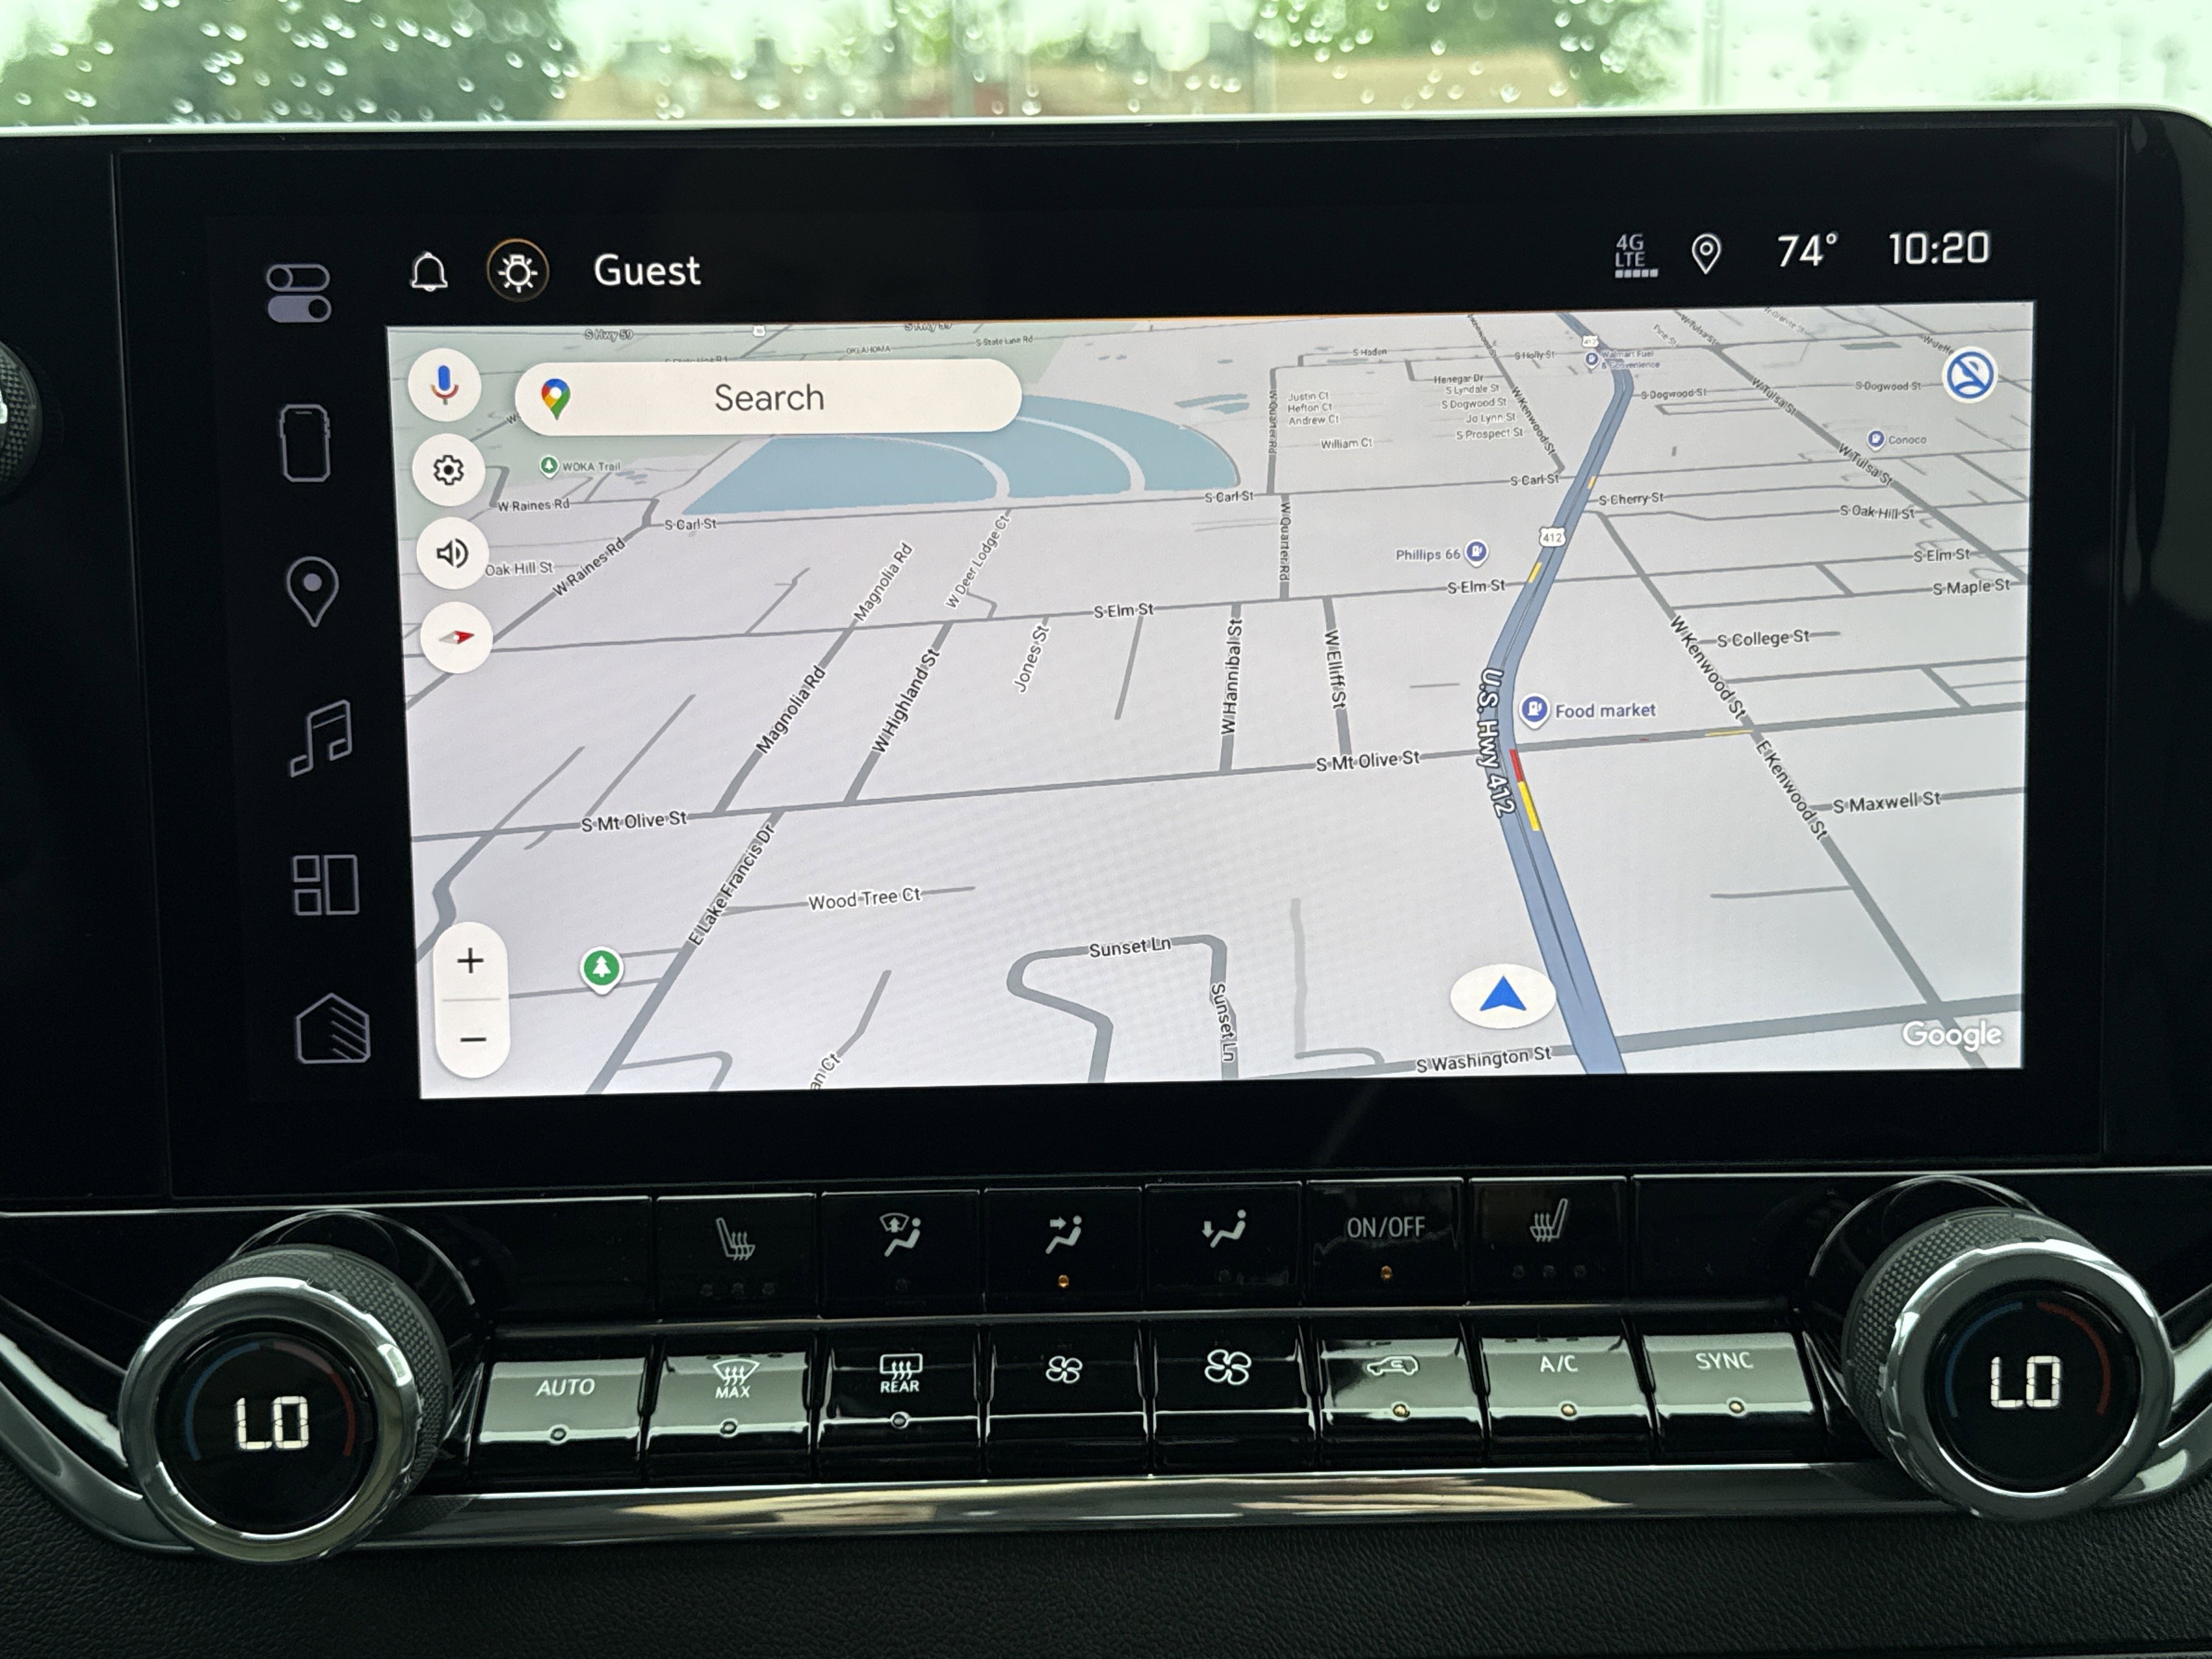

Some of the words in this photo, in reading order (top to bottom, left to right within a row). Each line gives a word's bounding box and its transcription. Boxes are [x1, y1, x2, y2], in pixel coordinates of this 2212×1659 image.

[1616, 234, 1644, 250] 4G
[1778, 233, 1837, 266] 74°
[1889, 231, 1991, 264] 10:20
[1616, 252, 1645, 266] LTE
[594, 253, 701, 286] Guest
[1446, 386, 1452, 394] S
[1454, 385, 1488, 396] Lyndale
[1491, 383, 1499, 392] St
[1856, 382, 1861, 390] S
[1865, 381, 1909, 392] Dogwood
[715, 383, 824, 411] Search
[1288, 393, 1316, 402] Justin
[1319, 392, 1329, 400] Ct
[1442, 400, 1448, 409] S
[1451, 398, 1494, 410] Dogwood
[1498, 398, 1506, 406] St
[1752, 377, 1764, 392] W
[1763, 386, 1786, 407] Tulsa
[1784, 400, 1797, 415] St
[1322, 403, 1332, 412] Ct
[1289, 416, 1325, 425] Andrew
[1329, 415, 1339, 424] Ct
[1511, 386, 1521, 398] W
[1517, 398, 1549, 443] Kenwood
[1544, 442, 1556, 455] St
[1457, 431, 1463, 439] S
[1466, 428, 1510, 440] Prospect
[1513, 427, 1523, 437] St
[1889, 436, 1927, 444] Conoco
[1321, 439, 1359, 449] William
[1361, 438, 1373, 448] Ct
[563, 462, 595, 471] WOKA
[599, 461, 620, 471] Trail
[1839, 442, 1854, 457] W
[1851, 451, 1879, 477] Tulsa
[1879, 471, 1892, 487] St
[1510, 476, 1518, 486] S
[1522, 476, 1544, 485] Carl
[1548, 474, 1559, 484] St
[498, 501, 510, 511] W
[512, 500, 550, 511] Raines
[555, 498, 569, 509] Rd
[1205, 493, 1212, 503] S
[1216, 492, 1238, 503] Carl
[1242, 491, 1254, 501] St
[1599, 496, 1606, 505] S
[1611, 494, 1649, 507] Cherry
[1652, 493, 1664, 502] St
[1281, 501, 1291, 514] W
[1840, 506, 1848, 516] S
[1853, 505, 1874, 517] Oak
[1878, 507, 1897, 520] Hill
[1902, 508, 1916, 519] St
[665, 520, 673, 530] S
[676, 519, 701, 530] Carl
[704, 518, 717, 529] St
[1280, 517, 1291, 564] Quarter
[1543, 533, 1562, 543] 412
[945, 595, 960, 610] W
[955, 568, 976, 595] Deer
[972, 530, 1000, 568] Lodge
[995, 514, 1010, 531] Ct
[1396, 549, 1442, 562] Phillips
[1445, 550, 1460, 560] 66
[1914, 550, 1922, 562] S
[1926, 550, 1951, 562] Elm
[1956, 548, 1970, 560] St
[486, 564, 510, 577] Oak
[515, 562, 535, 574] Hill
[539, 562, 553, 574] St
[554, 580, 569, 597] W
[567, 554, 608, 587] Raines
[607, 537, 625, 558] Rd
[1279, 566, 1289, 580] Rd
[854, 563, 900, 622] Magnolia
[894, 543, 912, 565] Rd
[1448, 582, 1457, 595] S
[1462, 581, 1487, 593] Elm
[1491, 580, 1505, 591] St
[1933, 583, 1943, 595] S
[1946, 580, 1990, 596] Maple
[1995, 579, 2010, 591] St
[1094, 607, 1103, 618] S
[1108, 605, 1134, 618] Elm
[1139, 603, 1154, 616] St
[1228, 618, 1243, 636] St
[1325, 629, 1339, 646] W
[1717, 634, 1727, 647] S
[1732, 631, 1789, 650] College
[1794, 629, 1809, 642] St
[1014, 644, 1041, 693] Jones
[1032, 624, 1049, 642] St
[1327, 651, 1346, 687] Elliff
[1670, 616, 1687, 635] W
[1680, 632, 1731, 701] Kenwood
[1729, 700, 1746, 720] St
[1222, 641, 1241, 714] Hannibal
[1477, 668, 1504, 713] U.S.
[872, 735, 889, 753] W
[884, 666, 928, 738] Highland
[921, 648, 940, 667] St
[1332, 691, 1346, 709] St
[755, 687, 810, 754] Magnolia
[804, 665, 826, 690] Rd
[1556, 704, 1594, 719] Food
[1601, 703, 1656, 717] market
[1221, 718, 1235, 735] W
[1477, 719, 1499, 769] Hwy
[1757, 741, 1772, 754] E
[1317, 758, 1327, 771] S
[1333, 756, 1354, 770] Mt
[1359, 753, 1398, 768] Olive
[1403, 751, 1420, 765] St
[1487, 774, 1516, 819] 412
[1764, 753, 1816, 822] Kenwood
[1833, 800, 1844, 814] S
[1850, 793, 1917, 812] Maxwell
[1923, 791, 1940, 805] St
[582, 819, 594, 833] S
[598, 816, 620, 832] Mt
[625, 812, 664, 829] Olive
[670, 810, 687, 826] St
[1810, 819, 1827, 840] St
[688, 932, 704, 947] E
[697, 897, 727, 933] Lake
[720, 843, 764, 899] Francis
[756, 822, 776, 843] Dr
[809, 893, 857, 911] Wood
[863, 891, 898, 906] Tree
[902, 888, 922, 903] Ct
[1090, 939, 1147, 958] Sunset
[1152, 936, 1171, 951] Ln
[1211, 983, 1235, 1040] Sunset
[1223, 1043, 1236, 1062] Ln
[1903, 1020, 2001, 1052] Google
[821, 1053, 840, 1071] Ct
[1417, 1059, 1427, 1073] S
[1432, 1049, 1528, 1071] Washington
[1534, 1046, 1551, 1060] St
[1347, 1216, 1425, 1239] ON/OFF
[1540, 1355, 1578, 1373] A/C
[1695, 1352, 1753, 1369] SYNC
[536, 1379, 596, 1397] AUTO
[880, 1380, 919, 1393] REAR
[1991, 1356, 2062, 1408] LO
[715, 1385, 750, 1399] MAX
[236, 1396, 308, 1450] LO
